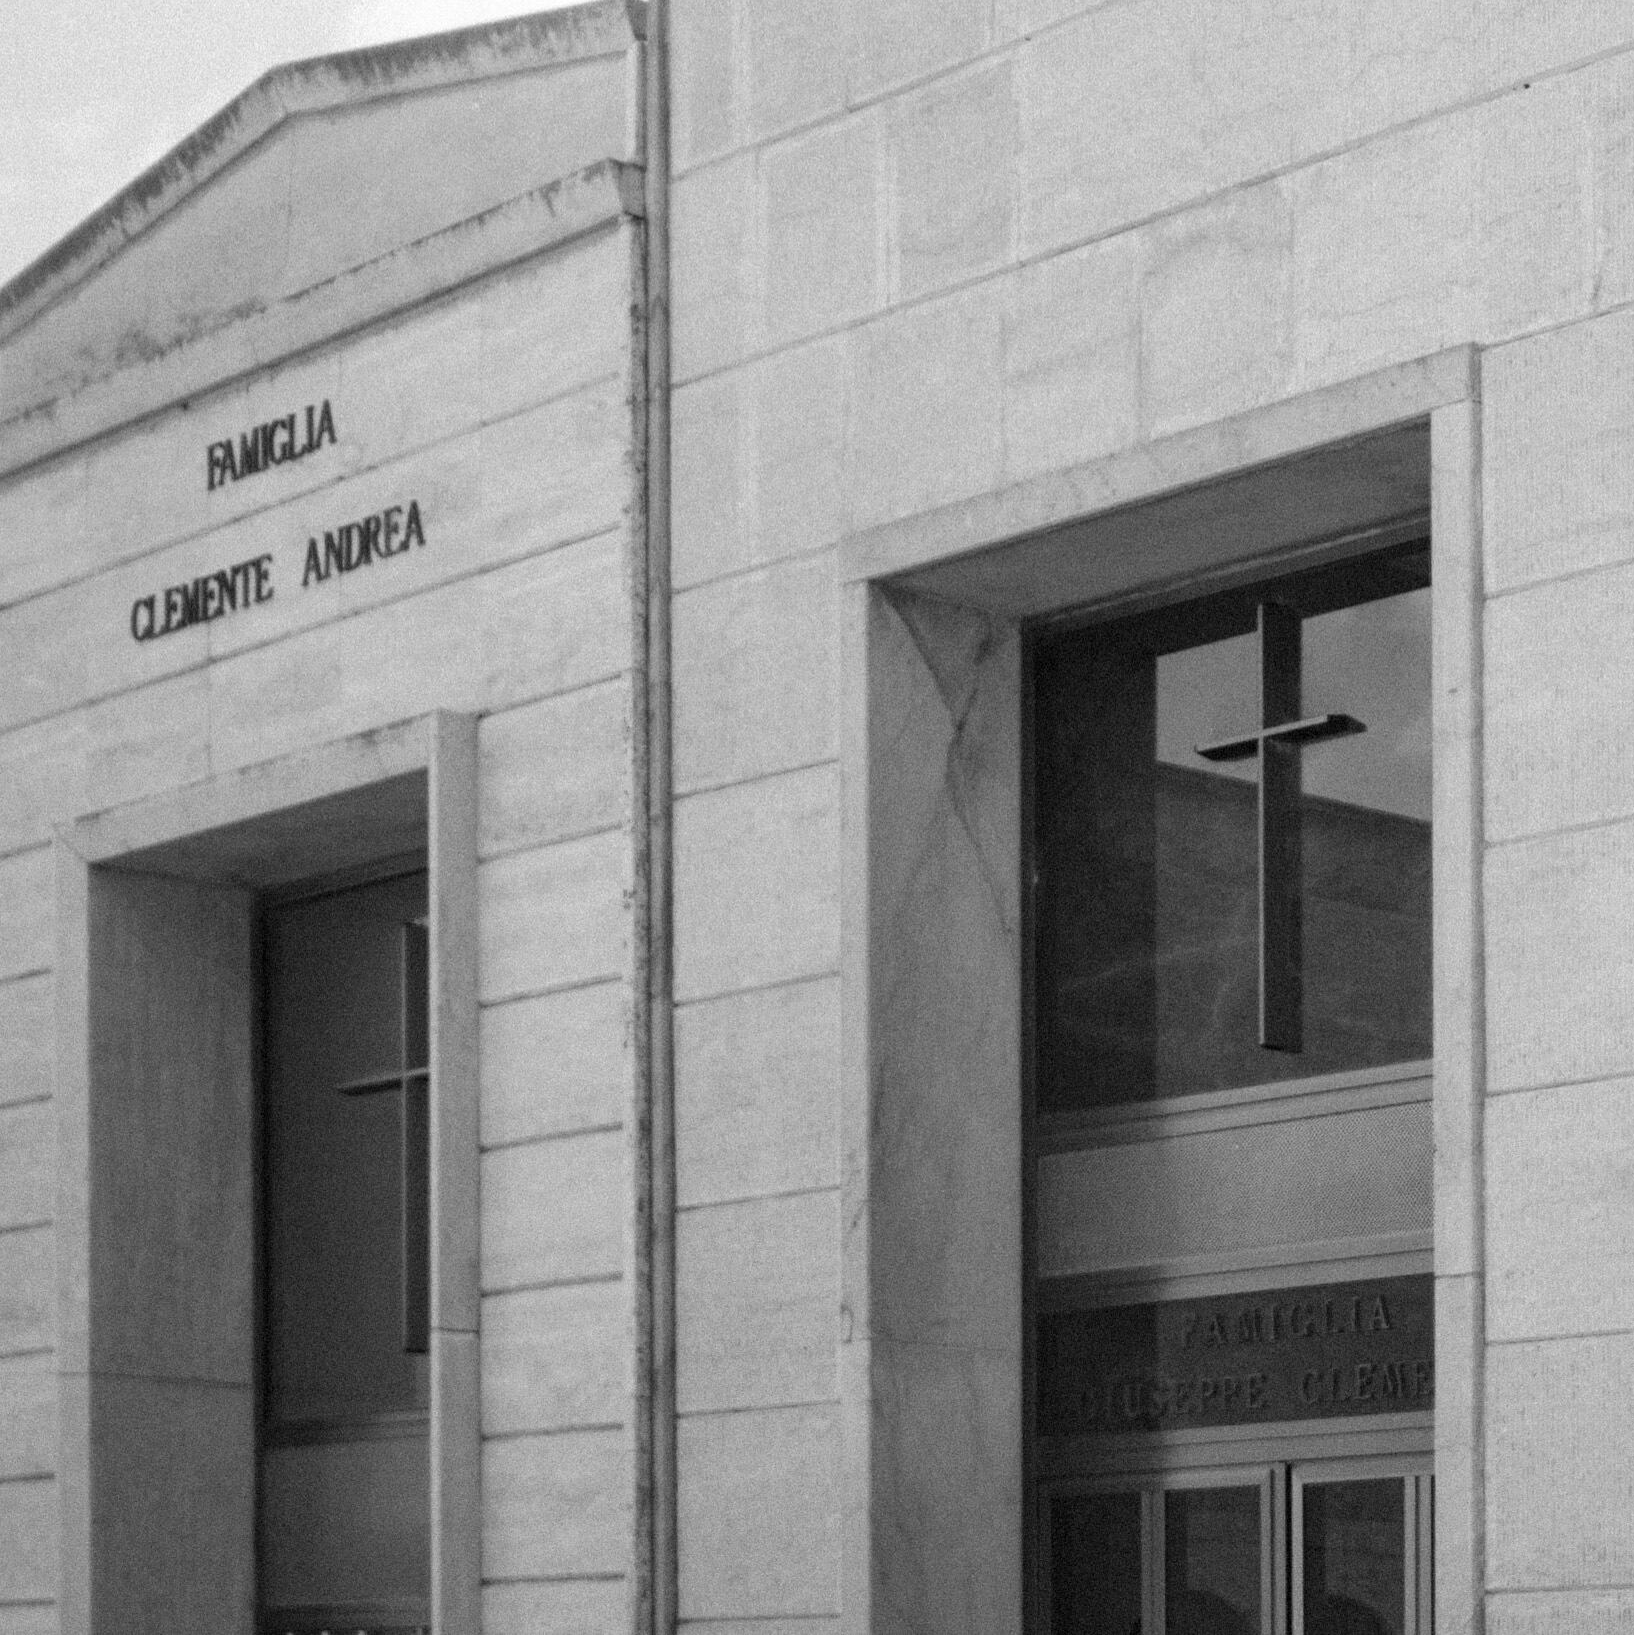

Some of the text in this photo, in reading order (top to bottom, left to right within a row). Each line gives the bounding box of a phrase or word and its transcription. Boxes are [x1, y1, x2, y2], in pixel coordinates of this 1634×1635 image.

[206, 398, 338, 491] FAMIGLIA
[130, 499, 427, 643] CLEMENTE ANDREA
[1181, 1294, 1393, 1349] FAMIGLIA
